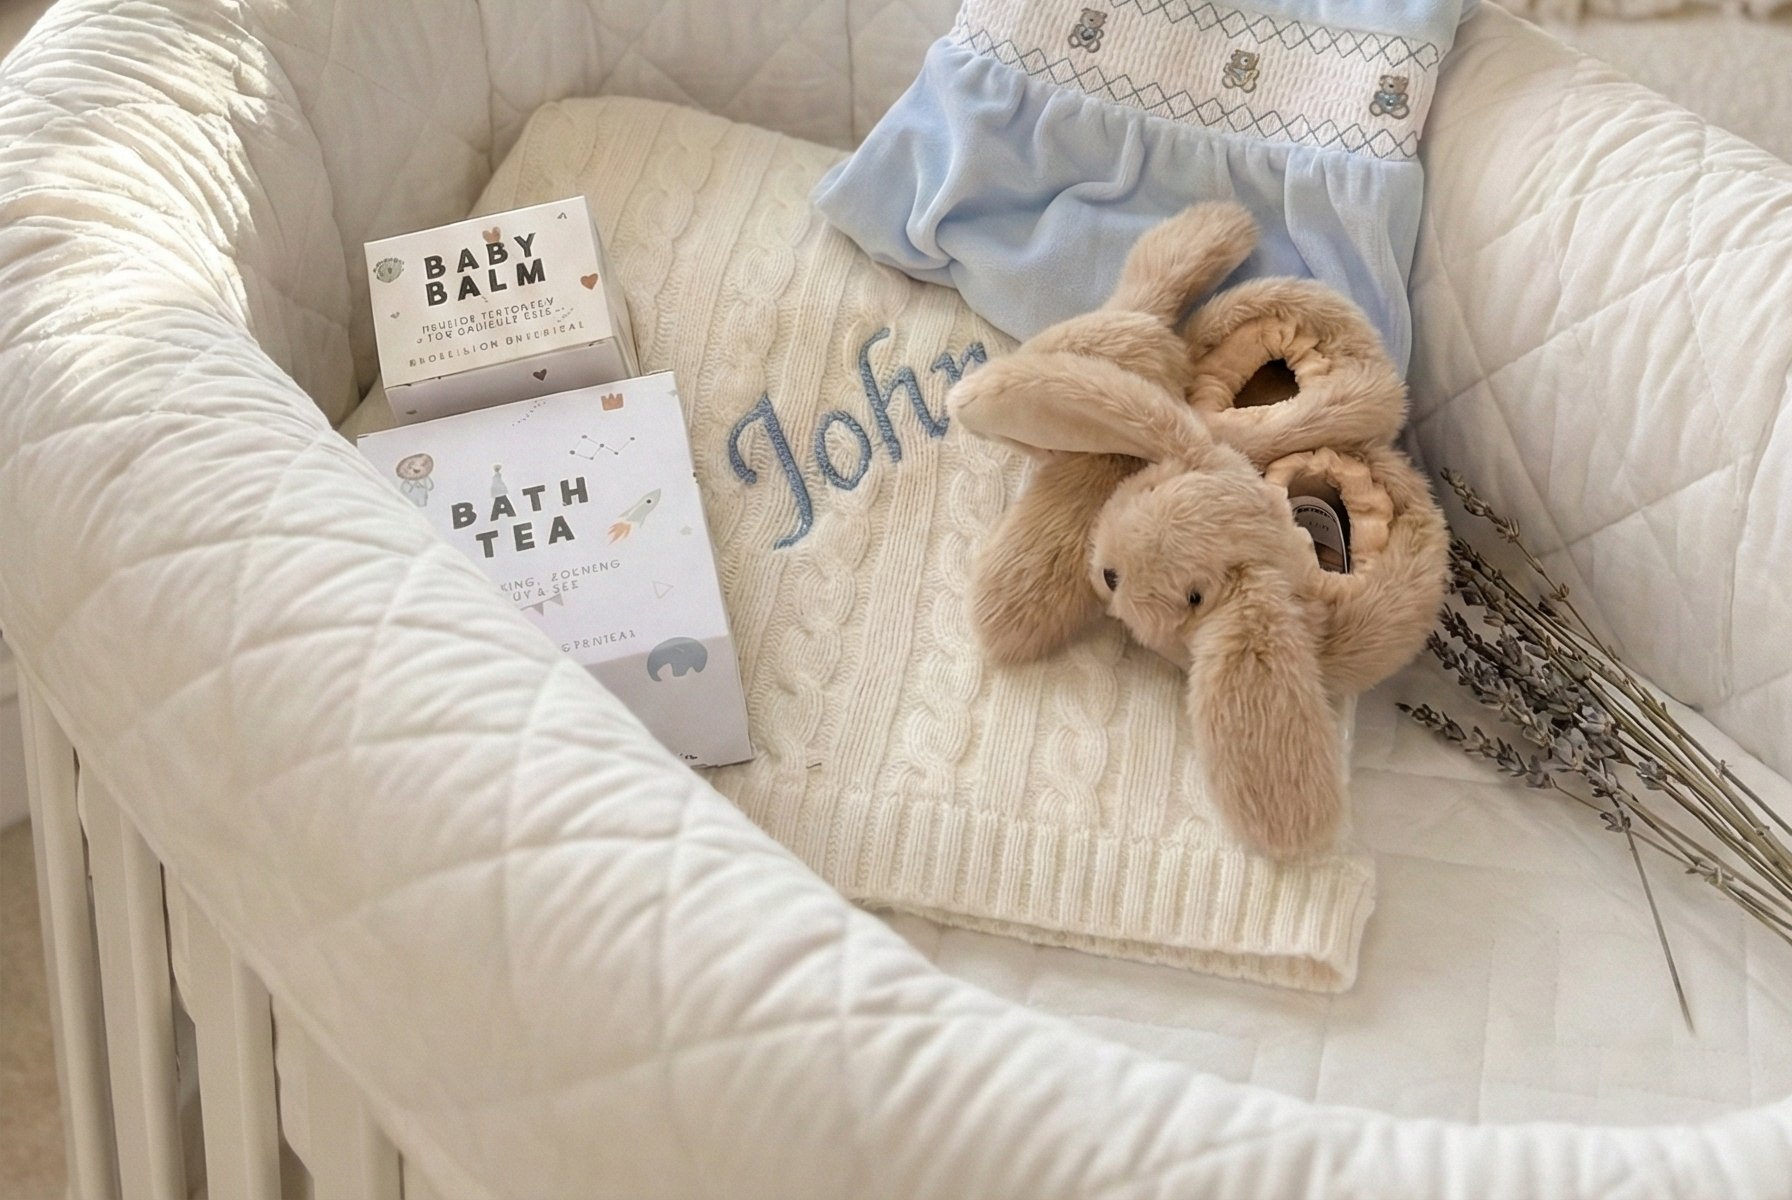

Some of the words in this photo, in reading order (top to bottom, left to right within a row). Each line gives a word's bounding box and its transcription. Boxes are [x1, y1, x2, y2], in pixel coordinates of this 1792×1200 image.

[424, 233, 537, 280] BABY
[425, 258, 546, 307] BALM
[451, 476, 589, 530] BATH
[475, 515, 576, 558] TEA
